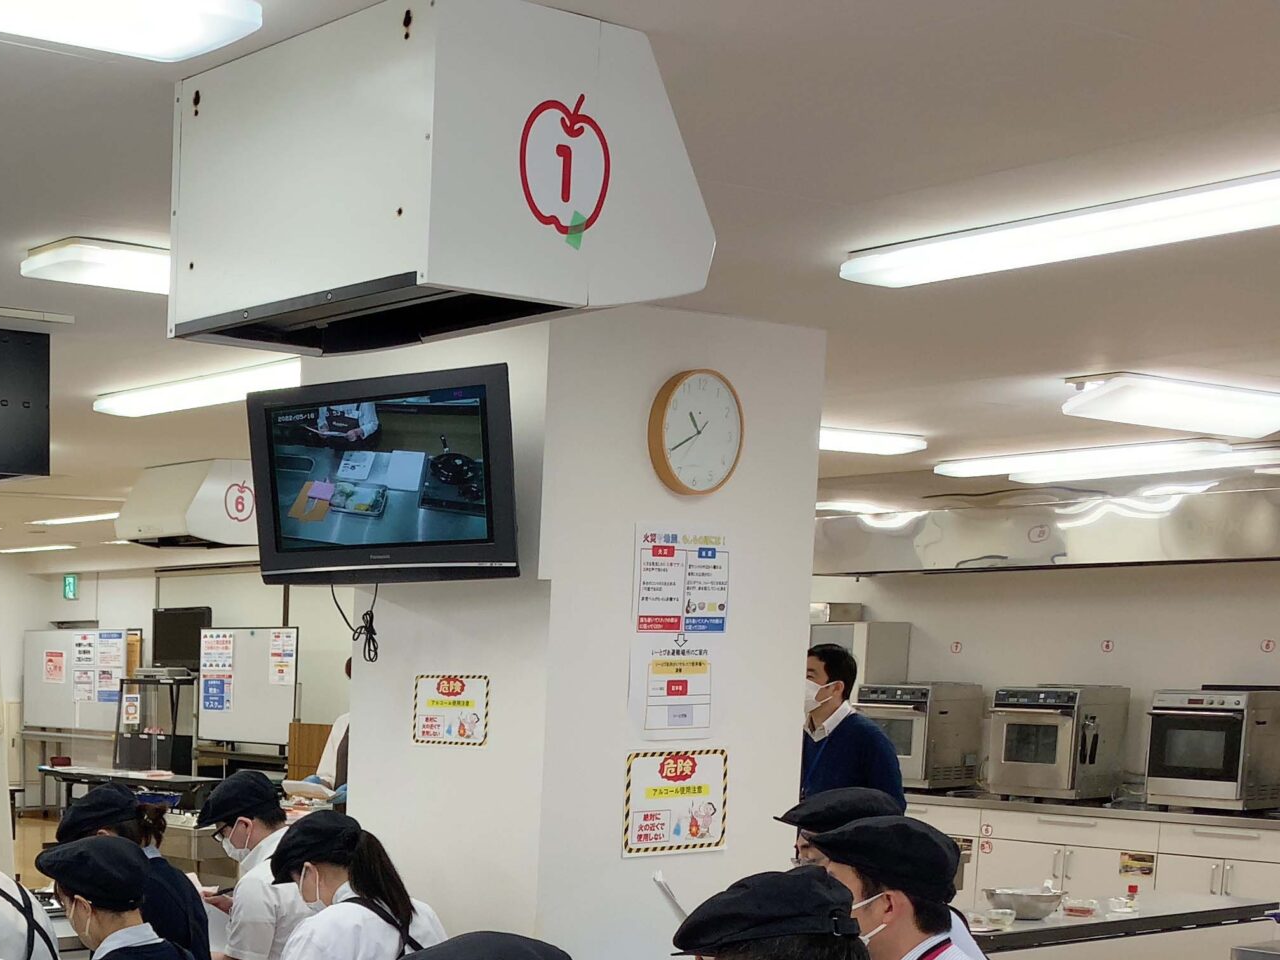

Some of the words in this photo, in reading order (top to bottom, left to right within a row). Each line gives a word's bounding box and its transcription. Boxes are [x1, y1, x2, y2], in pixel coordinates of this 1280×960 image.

[556, 143, 572, 203] 1
[682, 383, 691, 394] 11
[698, 378, 708, 391] 12
[707, 470, 713, 481] 5
[235, 495, 245, 513] 6
[438, 681, 462, 693] 危険
[663, 759, 693, 777] 危険
[652, 785, 703, 796] アルコール使用注意
[643, 812, 662, 821] 絶対に
[637, 822, 666, 832] 火の近くで
[636, 832, 665, 842] 使用しない
